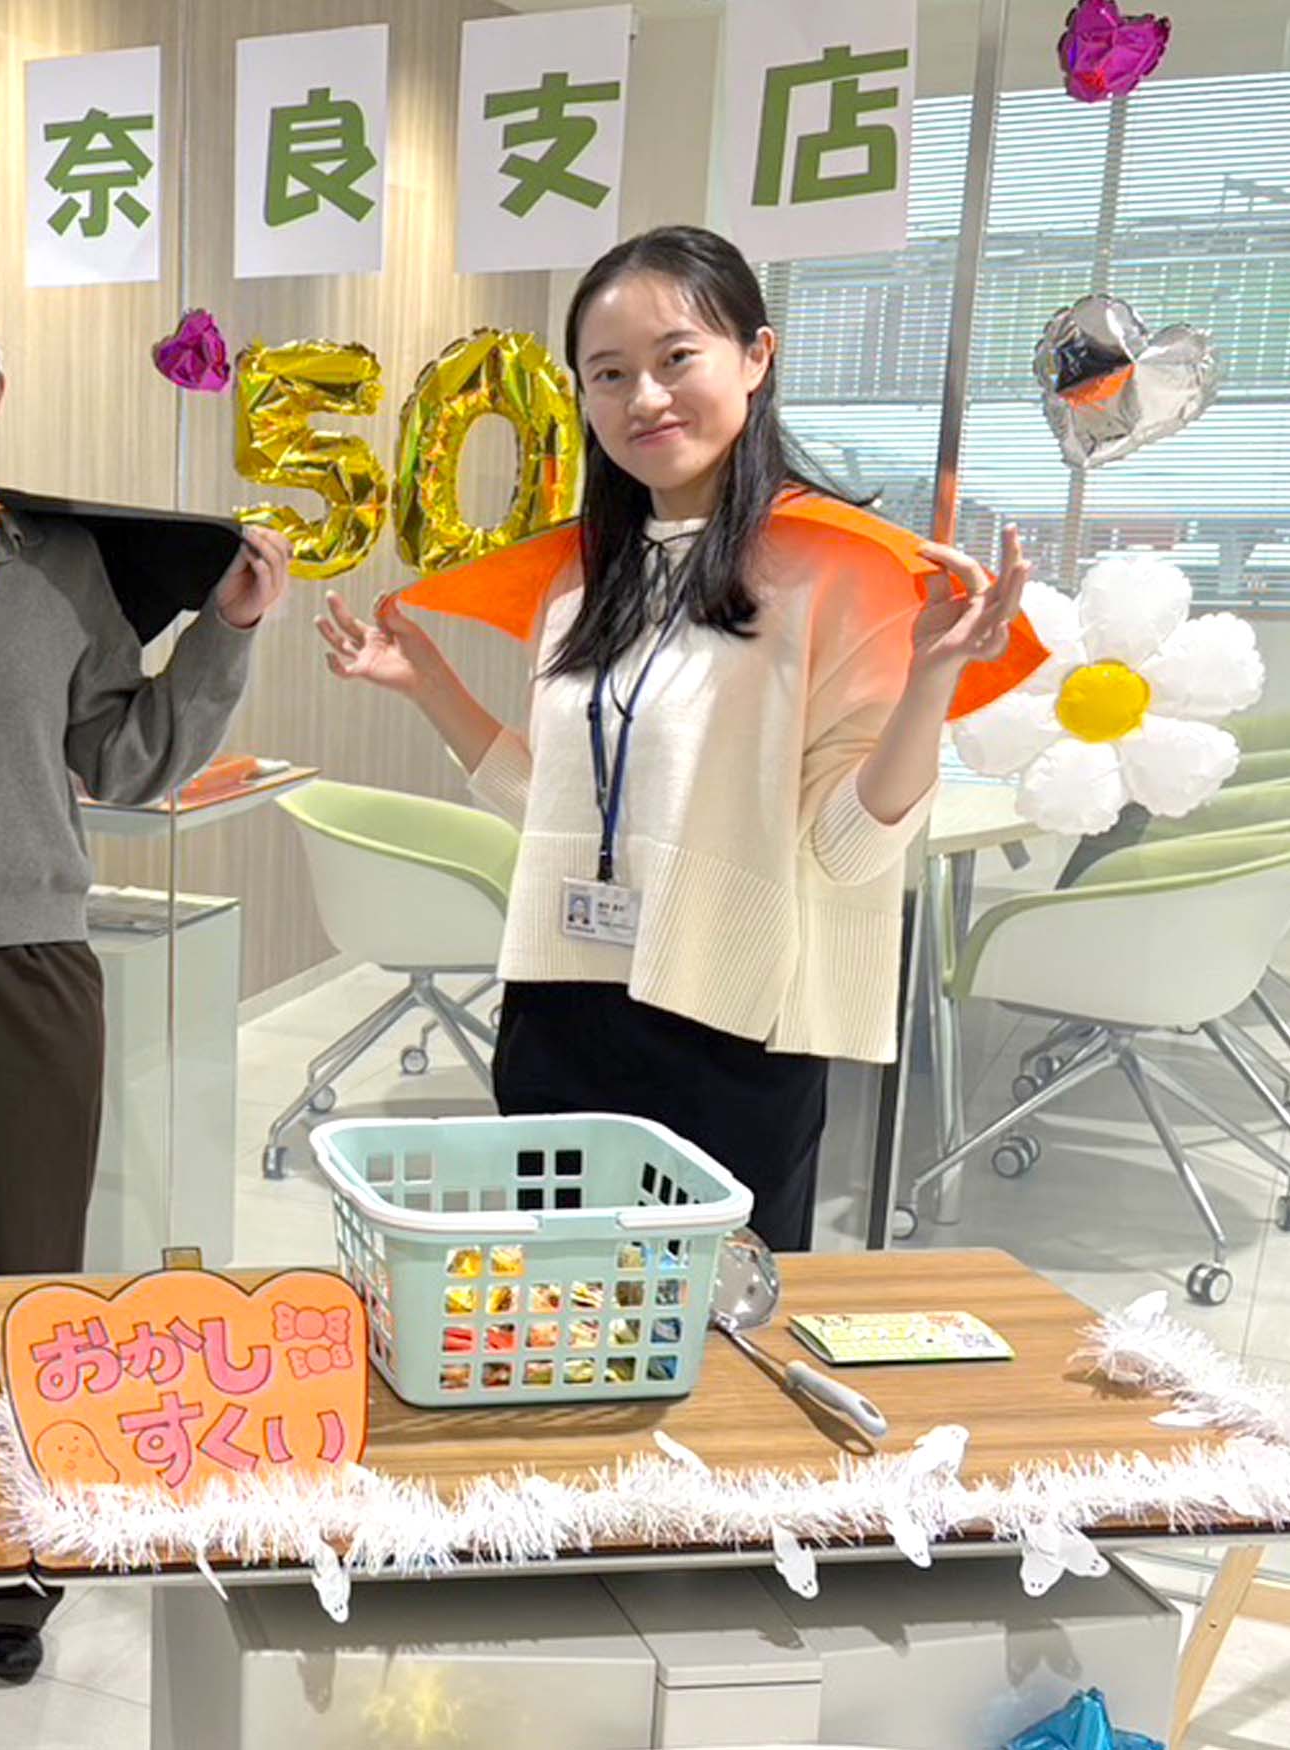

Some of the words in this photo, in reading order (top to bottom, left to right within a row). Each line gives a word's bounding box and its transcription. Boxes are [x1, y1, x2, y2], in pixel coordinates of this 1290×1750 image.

[43, 45, 909, 238] 奈良支店
[234, 329, 586, 580] 50
[30, 1316, 272, 1402] おかし
[118, 1391, 344, 1488] すくい
